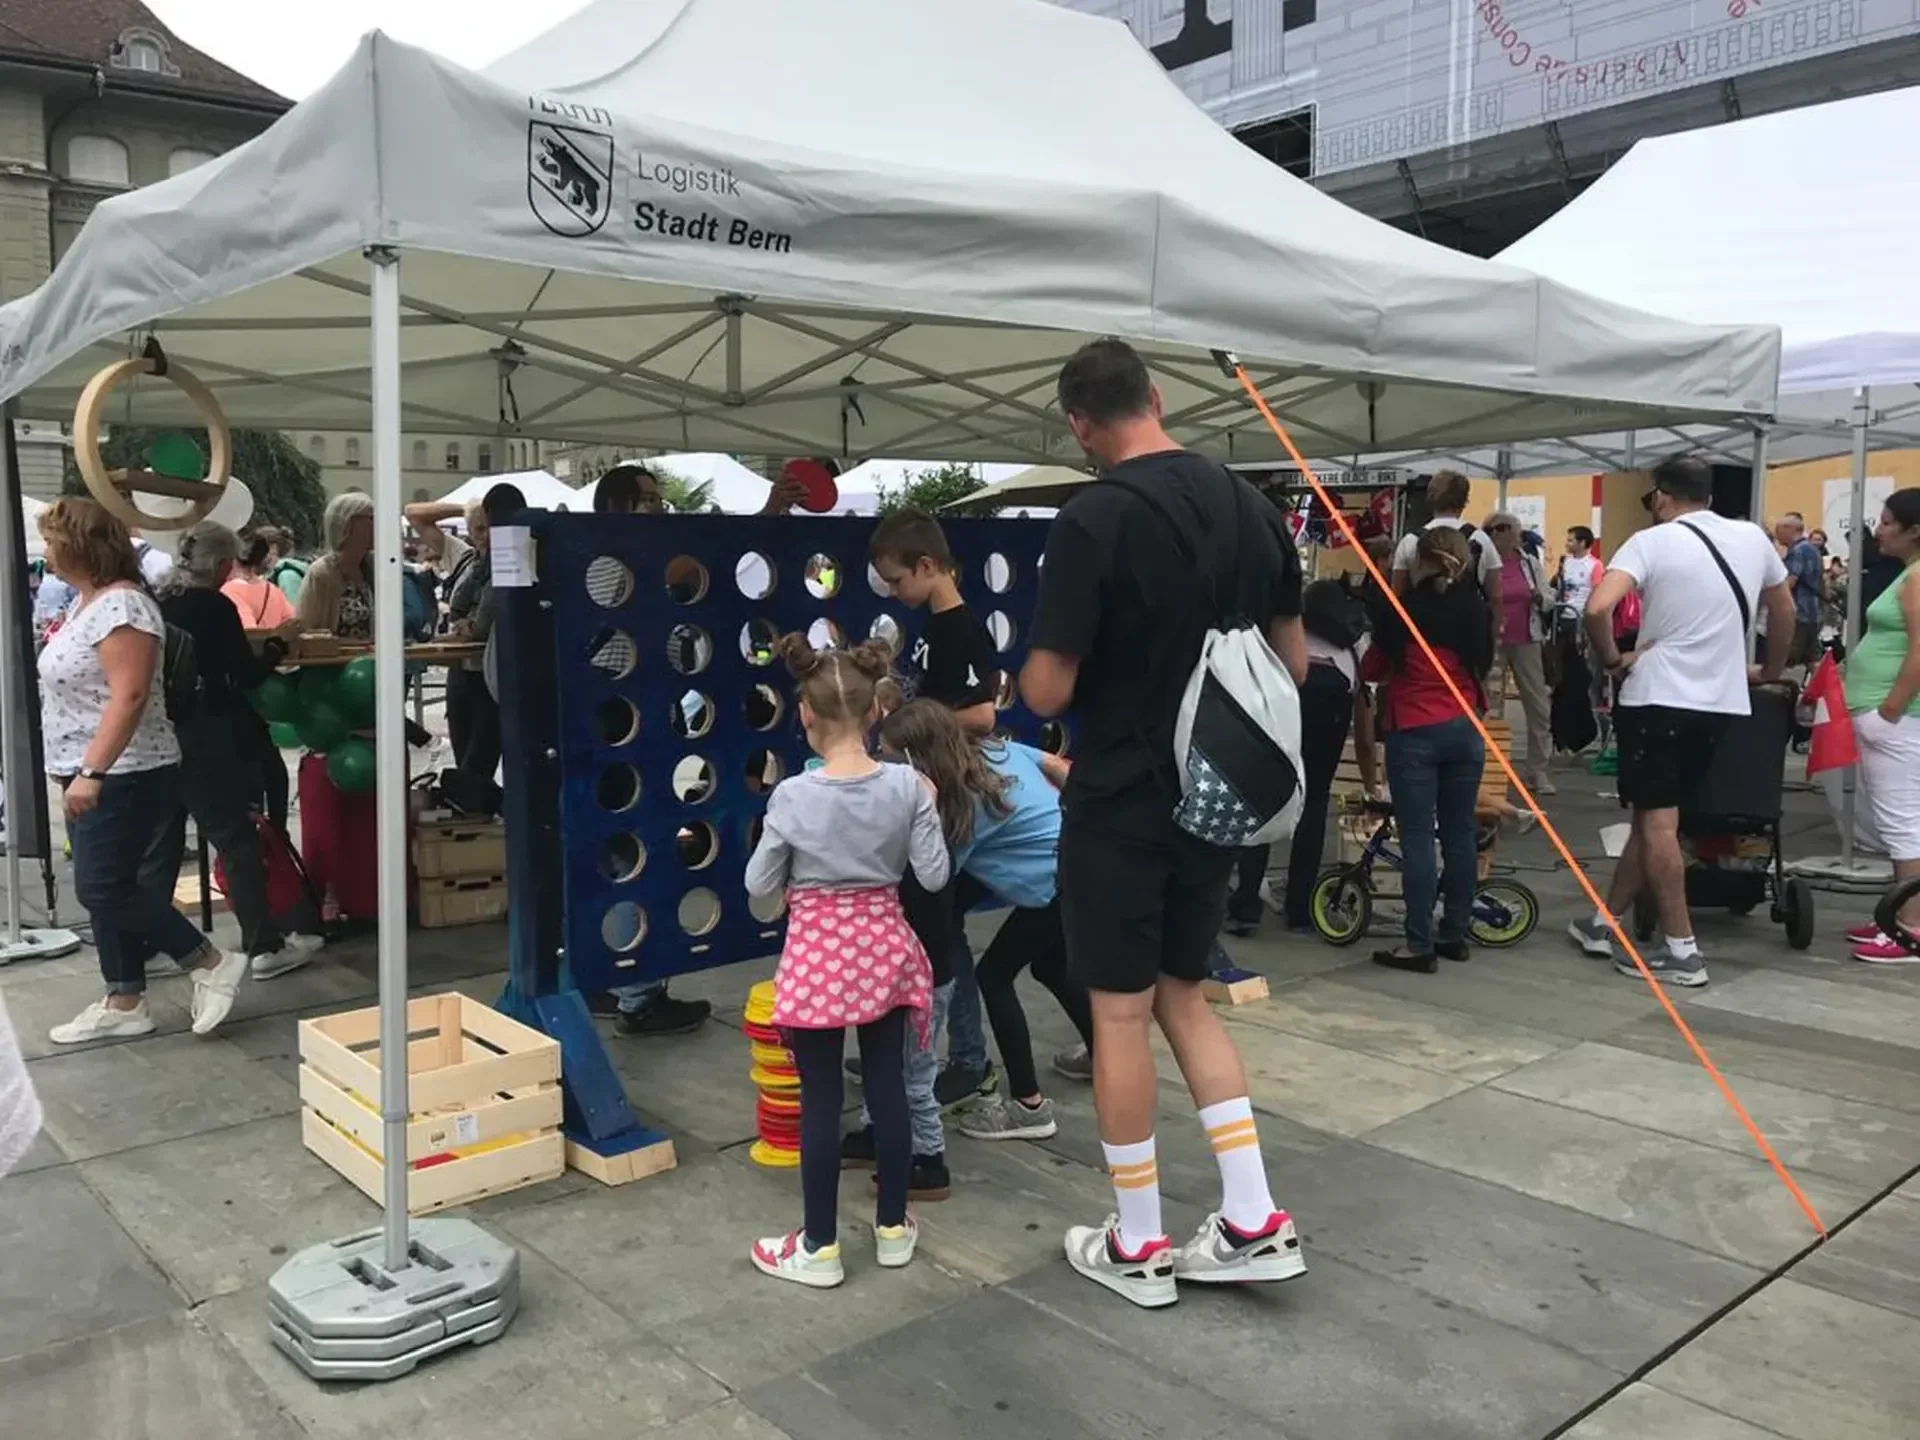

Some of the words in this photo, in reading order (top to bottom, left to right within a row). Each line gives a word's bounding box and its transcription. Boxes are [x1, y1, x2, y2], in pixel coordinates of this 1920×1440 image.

[638, 153, 742, 197] Logistik
[634, 201, 720, 242] Stadt
[728, 218, 792, 253] Bern
